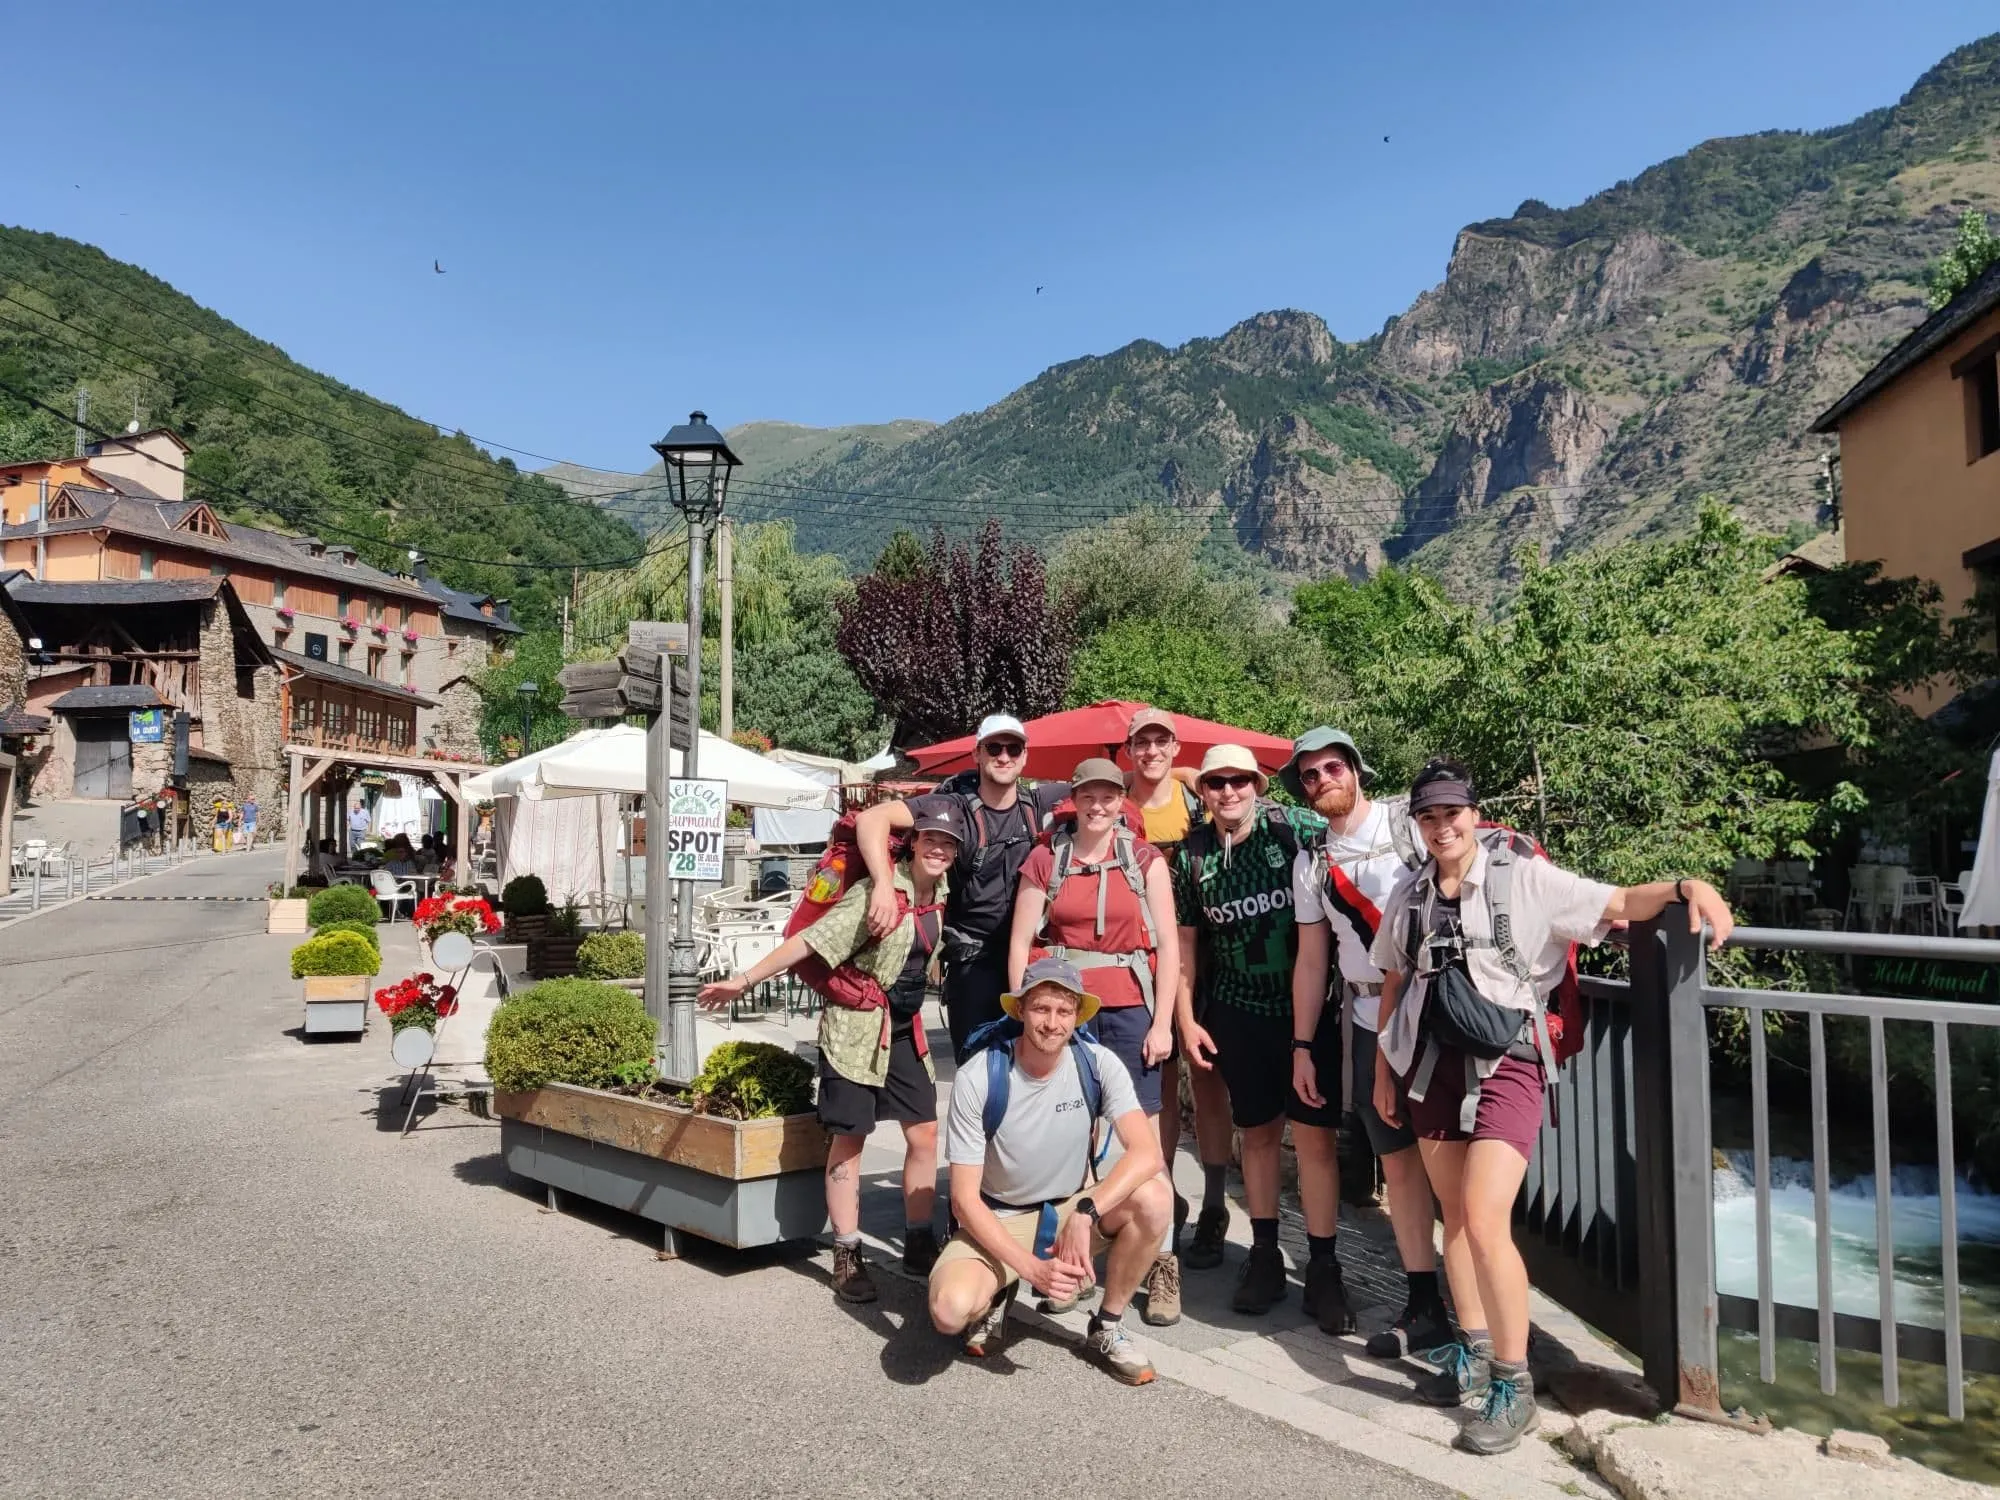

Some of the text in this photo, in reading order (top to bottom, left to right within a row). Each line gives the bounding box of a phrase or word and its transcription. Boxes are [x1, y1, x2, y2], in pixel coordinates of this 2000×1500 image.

[669, 811, 721, 829] ourmand
[669, 829, 721, 853] SPOT
[675, 853, 696, 871] 28
